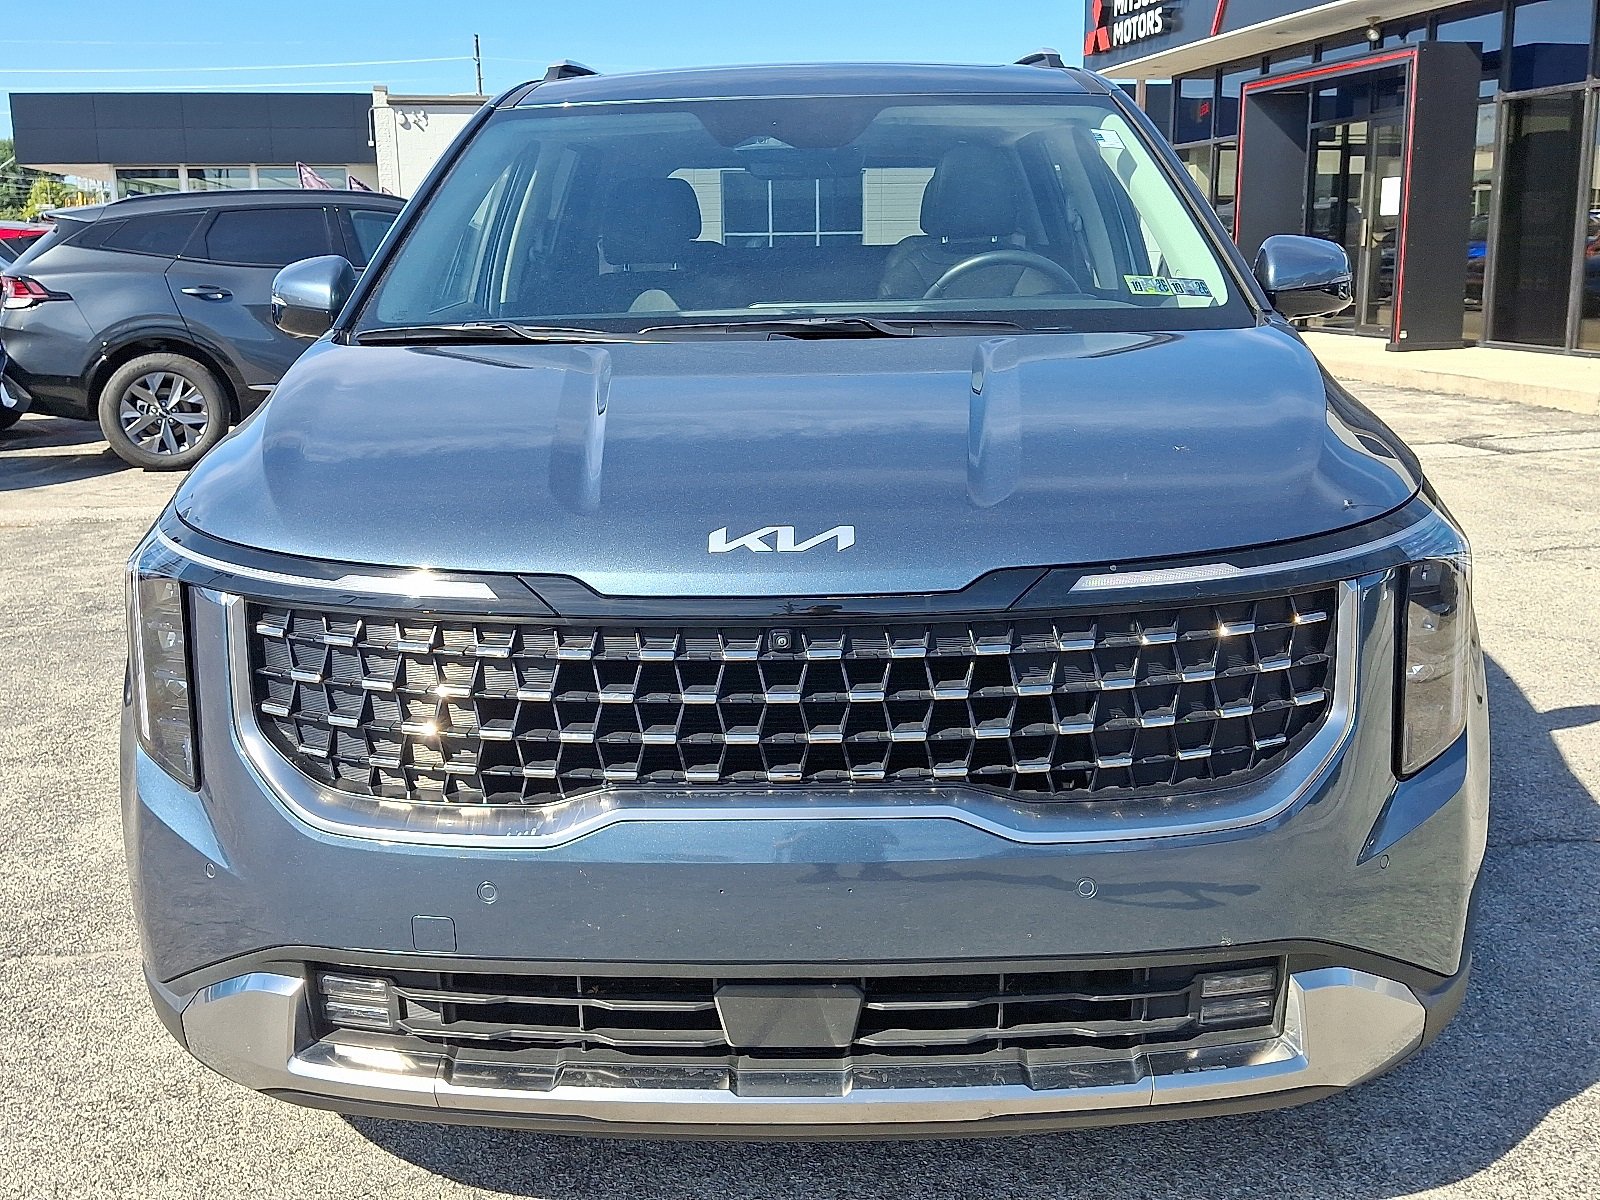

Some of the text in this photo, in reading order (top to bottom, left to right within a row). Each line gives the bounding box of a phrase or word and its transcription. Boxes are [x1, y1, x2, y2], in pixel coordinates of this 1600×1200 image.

[1113, 7, 1163, 46] MOTORS
[1131, 281, 1143, 291] 10
[1172, 283, 1184, 293] 10
